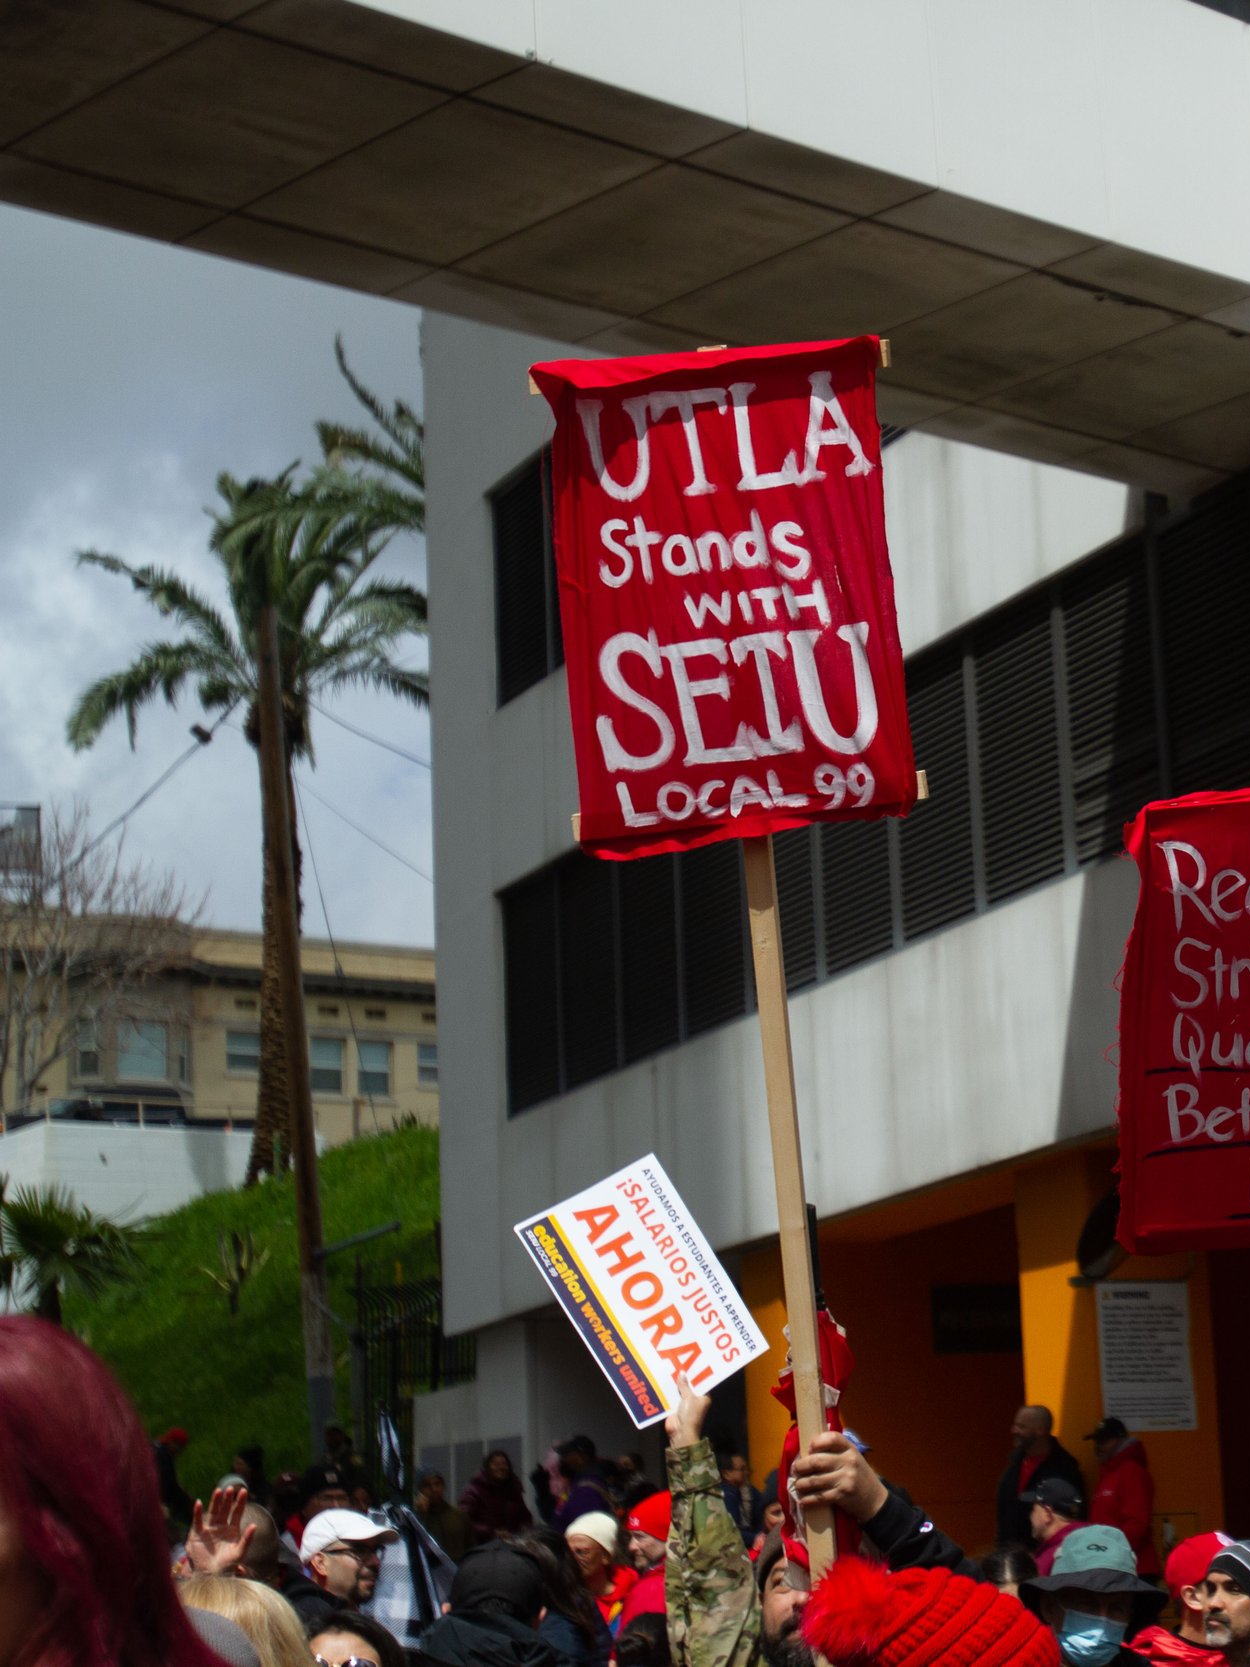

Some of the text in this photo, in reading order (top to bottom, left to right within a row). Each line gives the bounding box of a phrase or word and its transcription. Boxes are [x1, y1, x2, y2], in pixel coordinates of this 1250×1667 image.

[577, 370, 876, 501] UTLA
[599, 508, 811, 588] Stands
[684, 579, 830, 629] WITH
[596, 621, 878, 773] SEIU
[616, 763, 875, 827] LOCAL 99
[533, 1224, 660, 1417] education workers united
[572, 1203, 715, 1388] AHORA!
[616, 1178, 741, 1363] ¡SALARIOS JUSTOS
[642, 1168, 757, 1353] AYUDAMOS A ESTUDIANTES A APRENDER
